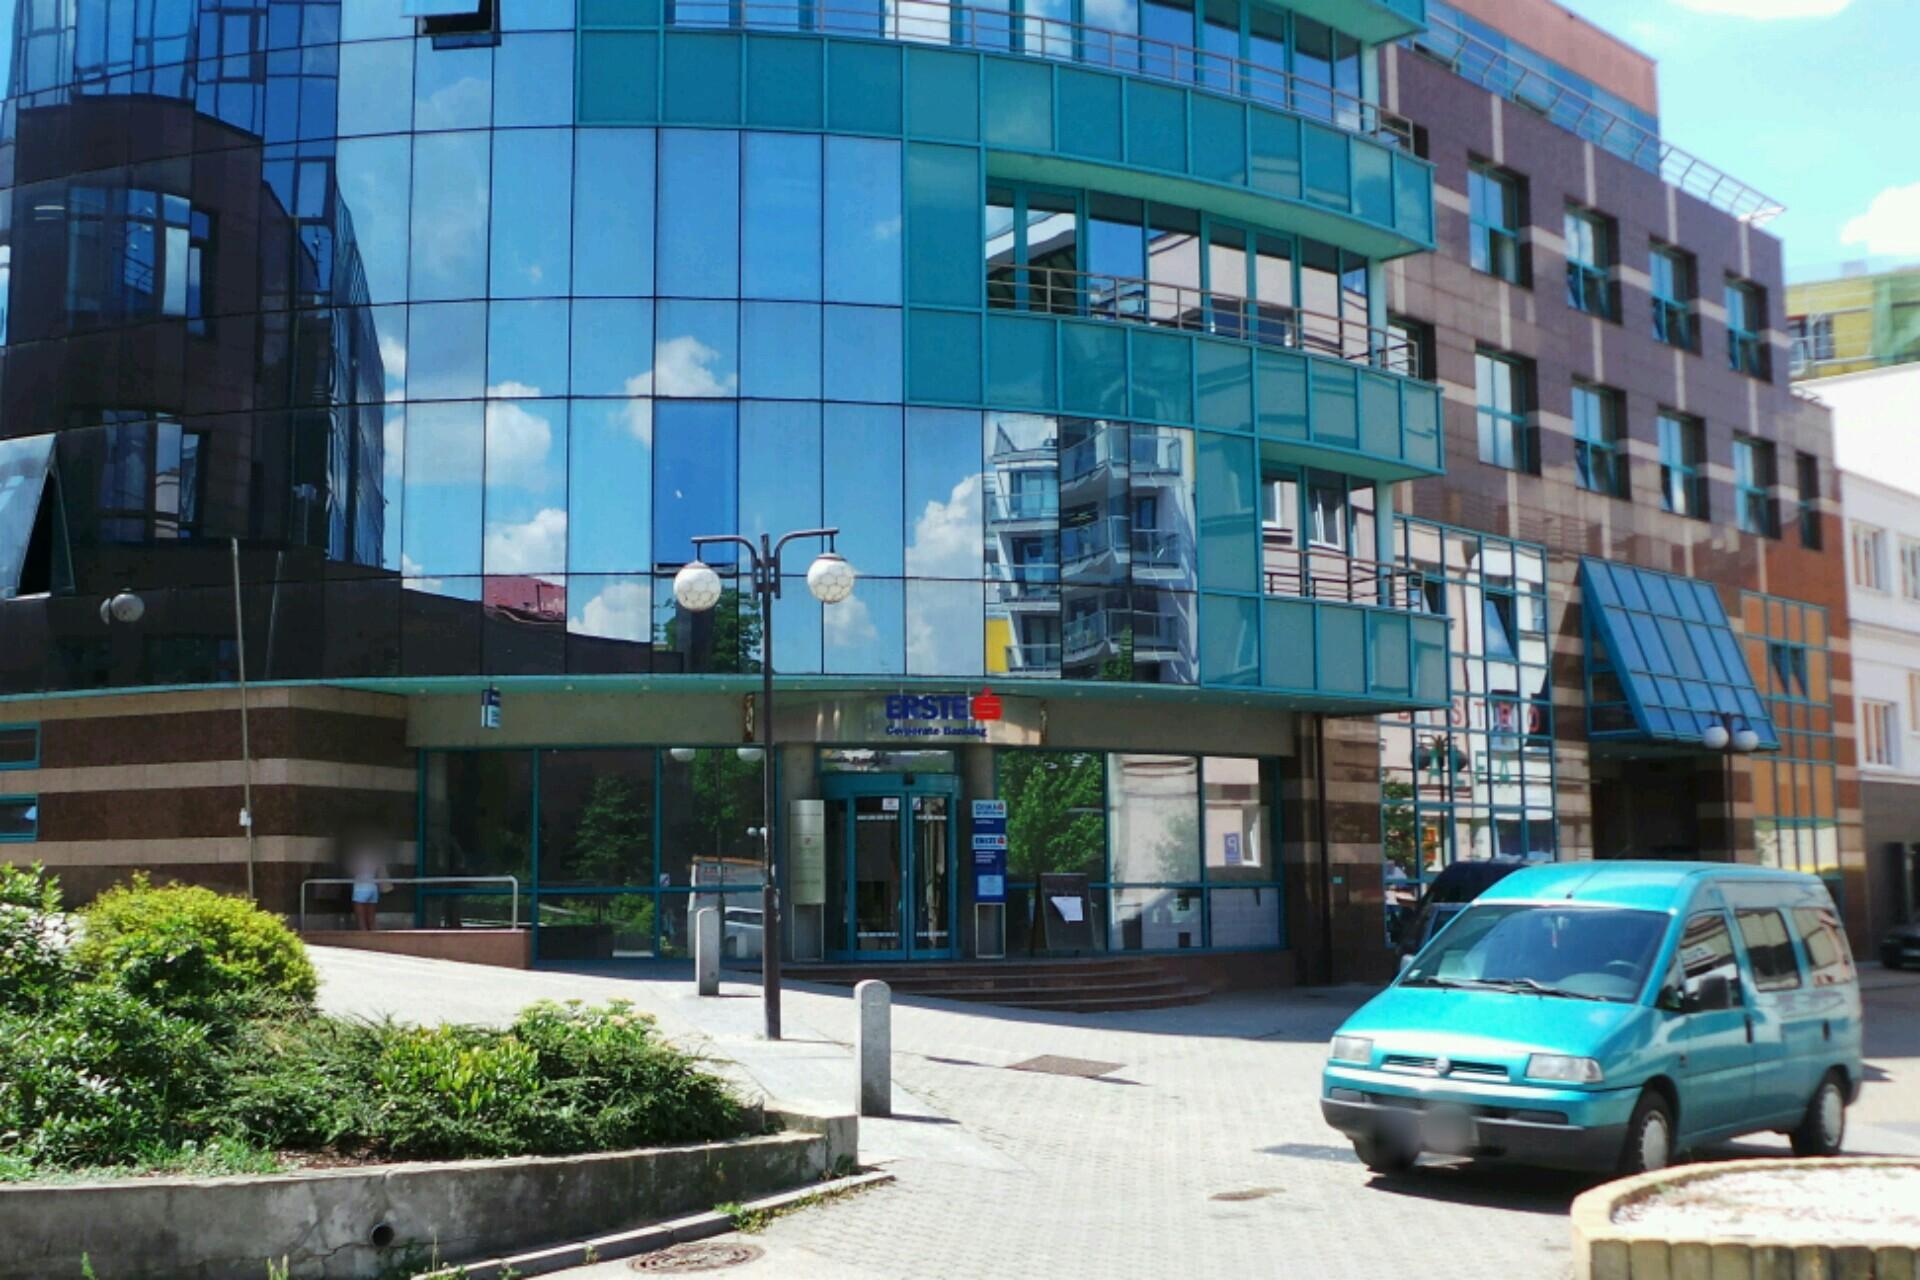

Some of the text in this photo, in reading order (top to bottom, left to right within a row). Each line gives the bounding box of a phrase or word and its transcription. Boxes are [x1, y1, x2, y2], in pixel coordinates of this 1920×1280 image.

[886, 695, 968, 720] ERSTE
[886, 726, 987, 737] Corporate Banking
